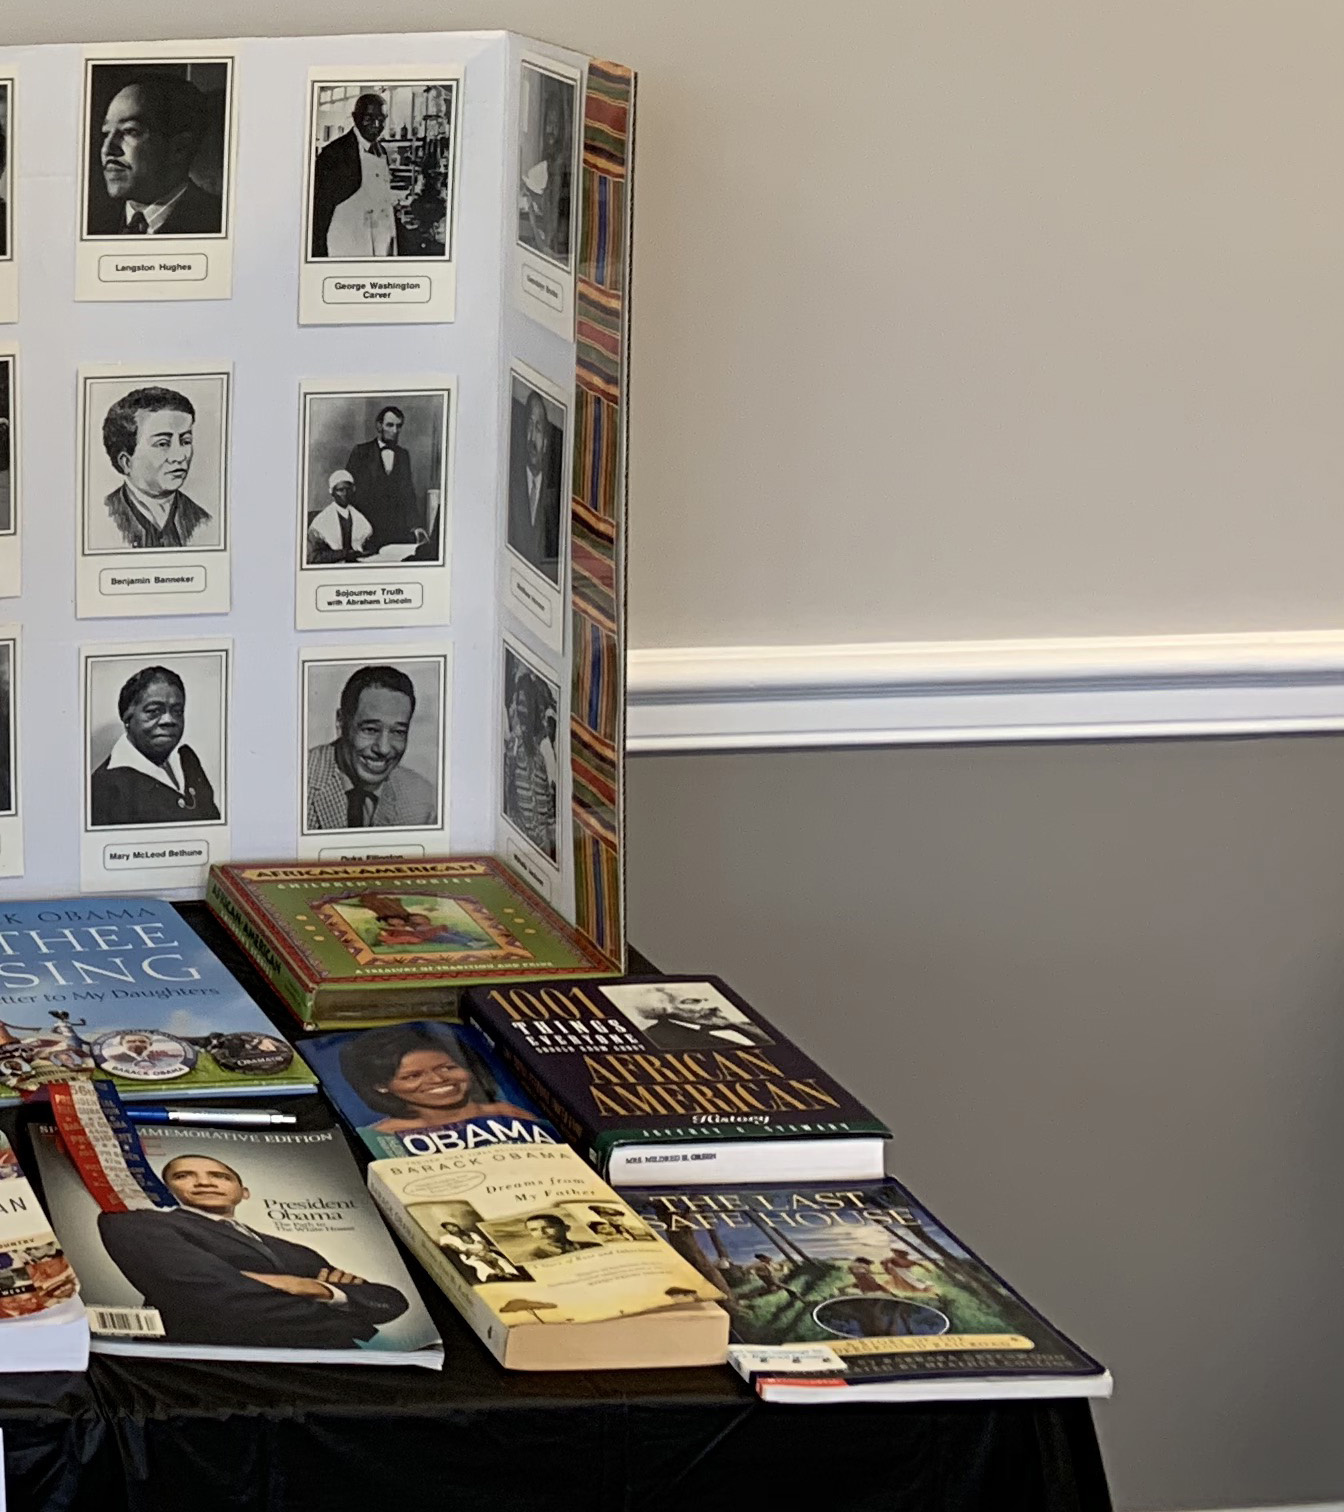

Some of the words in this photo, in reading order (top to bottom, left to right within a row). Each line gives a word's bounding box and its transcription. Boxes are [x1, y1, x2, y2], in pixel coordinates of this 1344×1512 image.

[115, 263, 155, 273] Langston
[159, 262, 192, 273] Hughes
[334, 282, 366, 292] George
[370, 282, 421, 292] Washington
[363, 291, 392, 299] Carver
[111, 577, 150, 587] Benjamin
[154, 575, 194, 585] Banneker
[335, 589, 377, 598] Sojourner
[381, 588, 404, 596] Truth
[384, 597, 412, 605] Lincoln
[109, 853, 130, 861] Mary
[133, 851, 166, 859] McLeod
[168, 849, 203, 858] Bethune
[37, 907, 156, 923] OBAMA
[43, 994, 66, 1004] to
[73, 992, 107, 1005] My
[112, 986, 220, 1002] Daughters
[487, 987, 610, 1022] 1001
[511, 1019, 628, 1035] THINGS
[525, 1033, 639, 1047] EVERYONE
[583, 1049, 787, 1085] AFRICAN
[588, 1078, 842, 1117] AMERICAN
[692, 1114, 771, 1125] History
[136, 1126, 262, 1144] MMEMORATIVE
[265, 1131, 334, 1145] EDITION
[403, 1120, 558, 1157] OBAMA
[390, 1157, 483, 1176] BARACK
[493, 1151, 572, 1163] OBAMA
[486, 1178, 544, 1194] Dreams
[550, 1175, 585, 1187] from
[515, 1192, 538, 1203] My
[545, 1187, 596, 1198] Father
[650, 1193, 752, 1214] THE
[756, 1191, 865, 1211] LAST
[263, 1198, 359, 1210] President
[267, 1209, 344, 1221] Obama
[638, 1213, 753, 1233] SAFE
[758, 1207, 923, 1231] HOUSE
